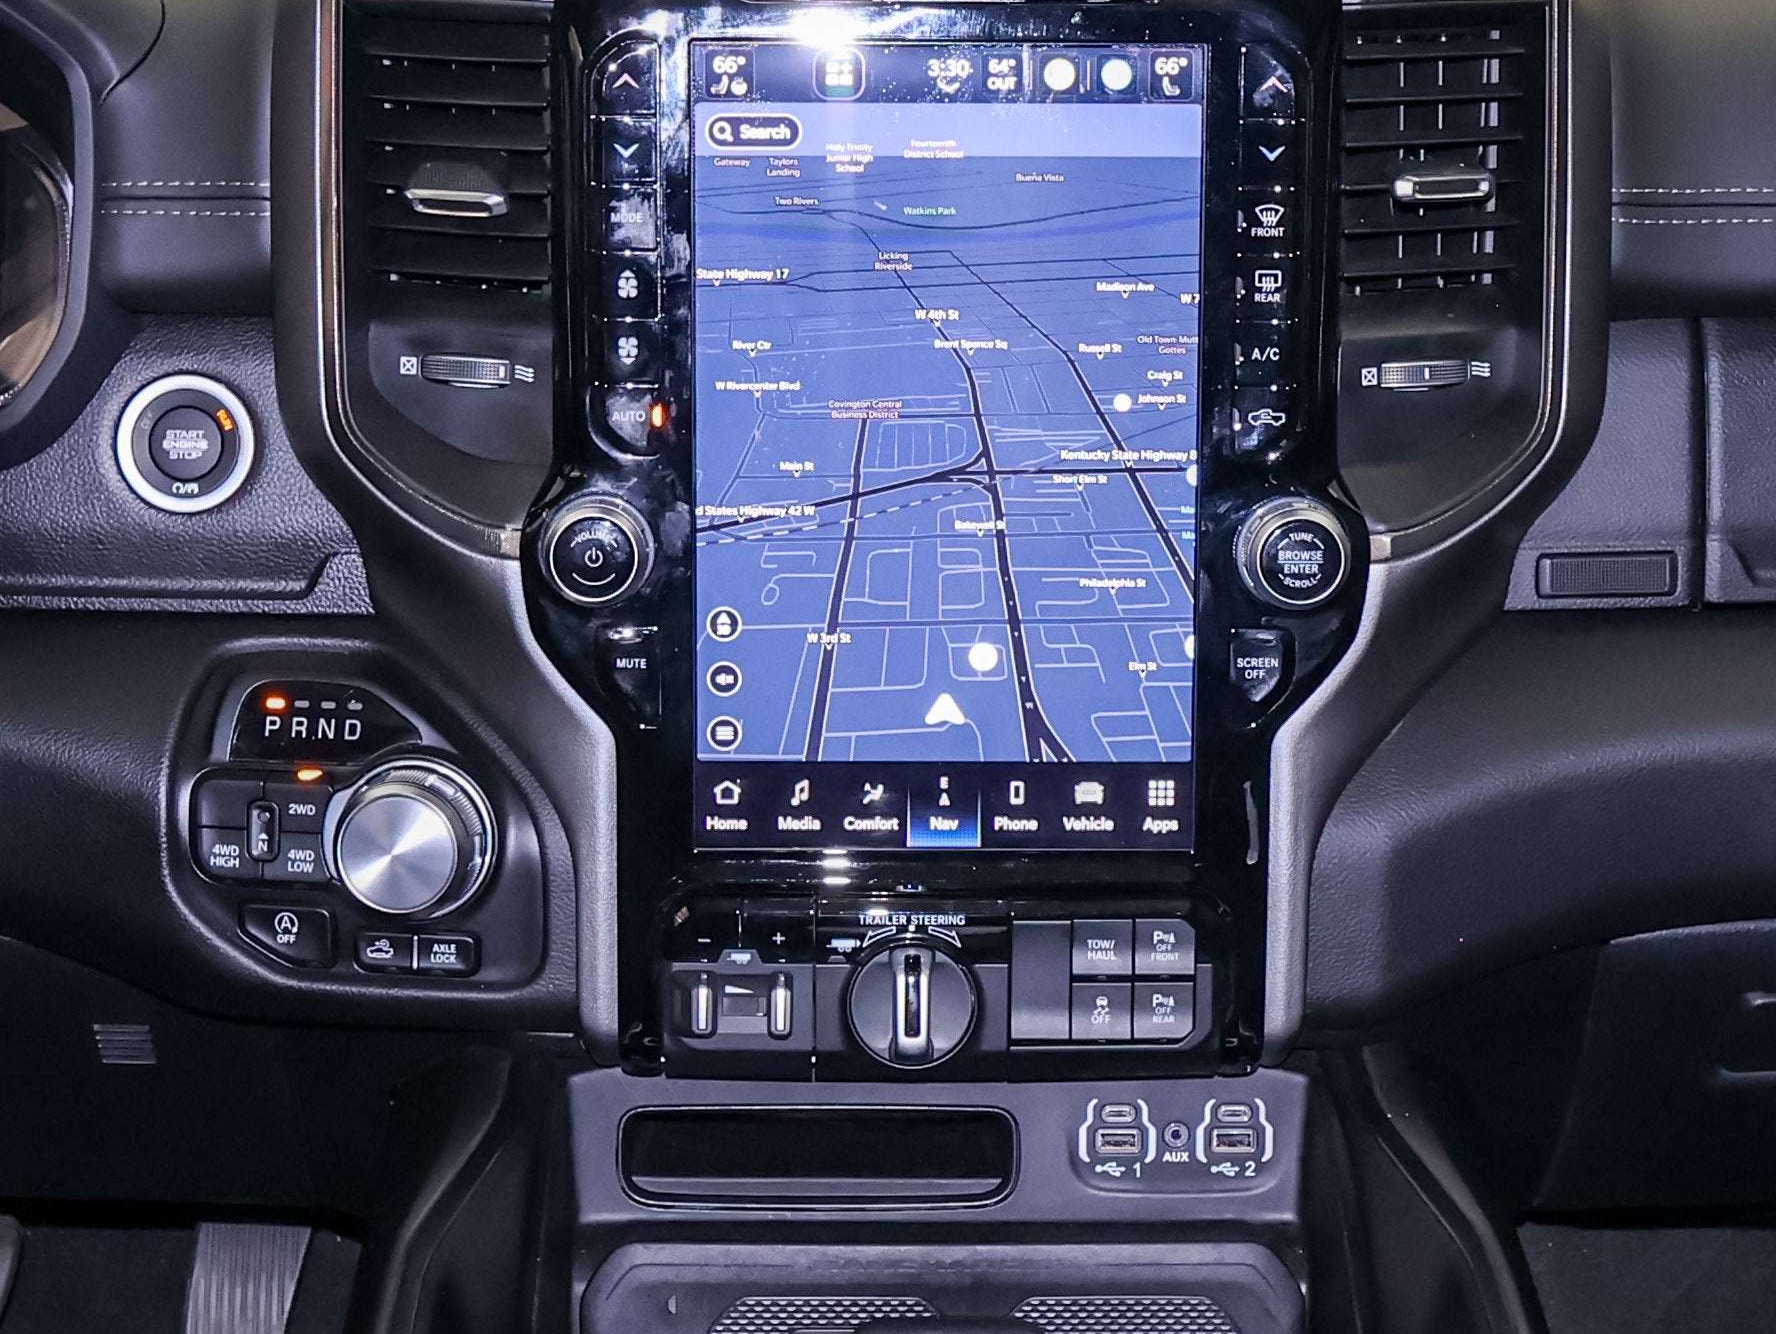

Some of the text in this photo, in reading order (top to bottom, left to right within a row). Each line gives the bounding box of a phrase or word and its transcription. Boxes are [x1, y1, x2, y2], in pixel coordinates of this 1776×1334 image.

[713, 55, 746, 74] 66°
[988, 58, 1017, 74] 64°
[1154, 57, 1188, 76] 66°
[987, 76, 1017, 91] OUT
[739, 123, 791, 140] Search
[910, 139, 957, 148] Fourteenth
[826, 153, 874, 164] Junior High
[903, 149, 965, 158] District School
[713, 157, 751, 168] Gateway
[768, 157, 799, 167] Taylors
[766, 168, 801, 179] Landing
[835, 164, 865, 173] School
[1043, 173, 1064, 182] Vista
[775, 197, 819, 206] Two Rivers
[903, 206, 956, 216] Watkins Park
[610, 213, 643, 223] MODE
[1251, 228, 1284, 237] FRONT
[879, 252, 908, 262] Licking
[875, 262, 912, 271] Riverside
[696, 269, 773, 282] State Highway
[1097, 282, 1155, 292] Madison Ave
[1255, 293, 1280, 302] REAR
[928, 309, 959, 320] 4th St
[1138, 335, 1152, 344] Old
[732, 341, 756, 350] River
[934, 340, 992, 351] Brent Spence
[1079, 343, 1122, 353] Russell St
[1158, 345, 1186, 355] Gottes
[1251, 347, 1280, 361] A/C
[1148, 371, 1183, 382] Craig St
[726, 381, 800, 390] Rivercenter Blvd
[1138, 394, 1186, 403] Johnson St
[828, 400, 902, 411] Covington Central
[612, 410, 646, 421] AUTO
[831, 410, 899, 420] Business District
[165, 429, 204, 439] START
[162, 439, 209, 449] ENGINE
[169, 450, 202, 460] STOP
[1061, 450, 1187, 462] Kentucky State Highway
[780, 461, 814, 471] Main St
[1053, 474, 1096, 484] Short Elm
[705, 506, 786, 519] States Highway
[955, 520, 993, 530] Bakewell
[575, 531, 611, 543] VOLUME
[1289, 533, 1313, 543] TUNE
[1278, 551, 1323, 561] BROWSE
[1284, 565, 1319, 574] ENTER
[1080, 579, 1146, 589] Philadelphia St
[1284, 577, 1318, 589] SCROLL
[820, 633, 838, 643] 3rd
[617, 658, 647, 668] MUTE
[1129, 662, 1146, 671] Elm
[1237, 658, 1279, 668] SCREEN
[1245, 669, 1265, 679] OFF
[265, 716, 361, 740] P R N D
[288, 803, 316, 815] 2WD
[706, 816, 748, 830] Home
[777, 816, 821, 830] Media
[843, 816, 899, 830] Comfort
[930, 816, 959, 830] Nav
[993, 816, 1039, 831] Phone
[1062, 816, 1115, 831] Vehicle
[1142, 817, 1179, 833] Apps
[212, 844, 239, 856] 4WD
[288, 849, 315, 861] 4WD
[210, 856, 239, 867] HIGH
[287, 861, 314, 872] LOW
[859, 915, 966, 925] TRAILER STEERING
[277, 934, 296, 944] OFF
[433, 943, 457, 954] AXLE
[1087, 939, 1115, 950] TOW/
[1156, 943, 1173, 952] OFF
[431, 954, 457, 964] LOCK
[1088, 950, 1116, 960] HAUL
[1151, 952, 1179, 961] FRONT
[1155, 1007, 1172, 1015] OFF
[1091, 1014, 1112, 1025] OFF
[1152, 1015, 1175, 1024] REAR
[1162, 1151, 1190, 1163] AUX
[1245, 1161, 1257, 1177] 2
